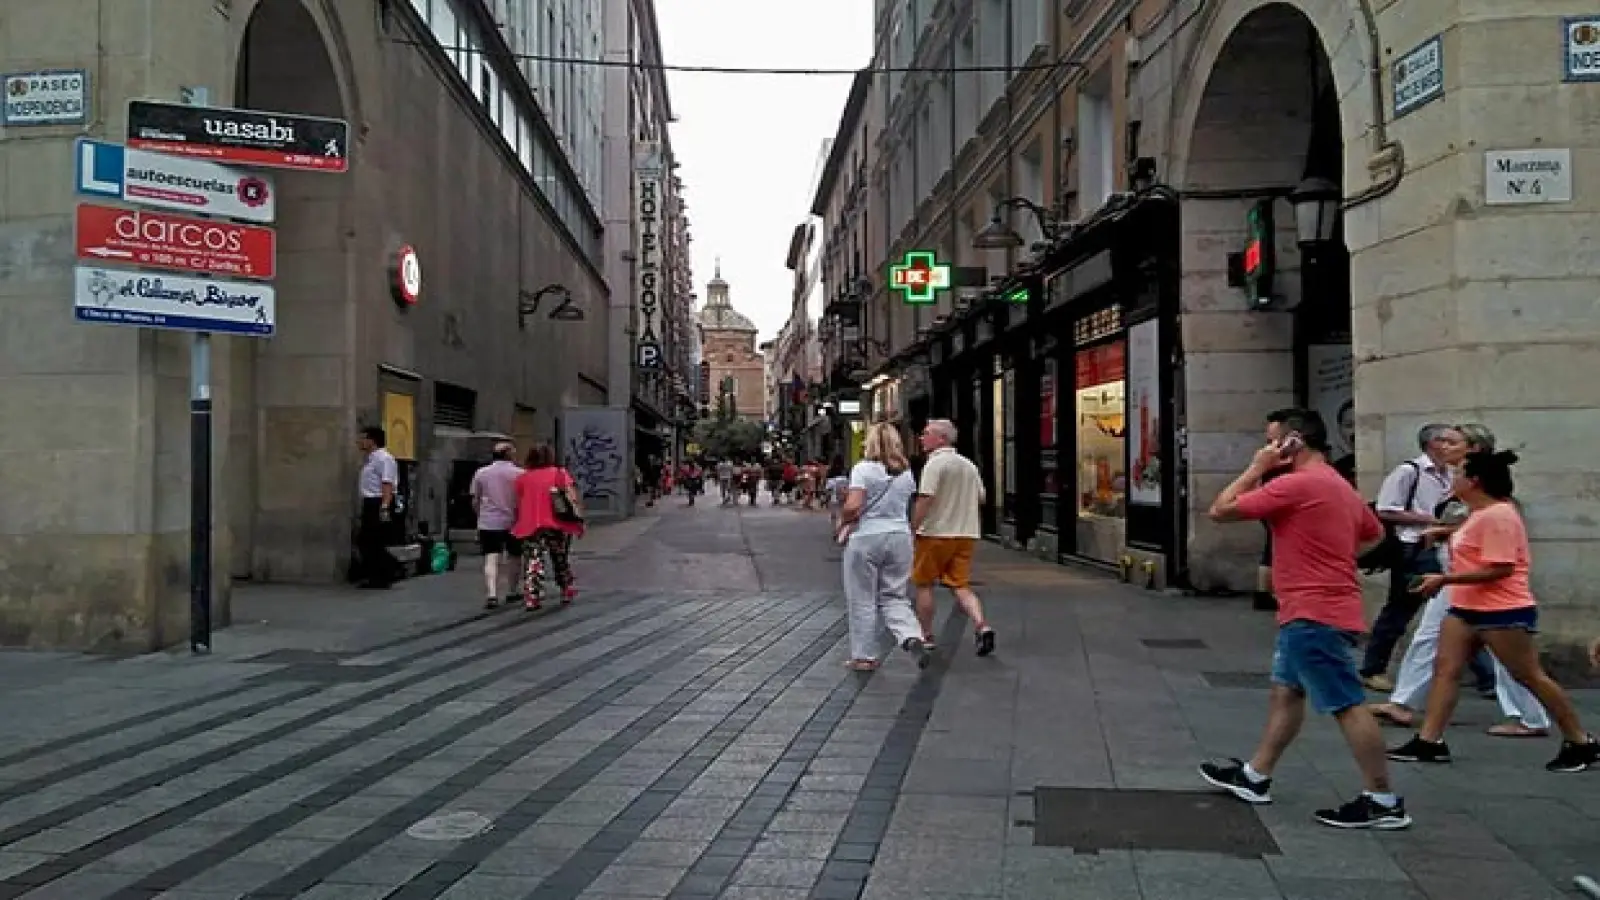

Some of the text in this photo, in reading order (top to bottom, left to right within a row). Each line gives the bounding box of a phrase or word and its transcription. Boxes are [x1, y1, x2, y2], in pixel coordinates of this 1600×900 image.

[31, 78, 81, 92] PASEO
[204, 118, 295, 142] uasabi
[82, 143, 120, 195] L
[126, 167, 233, 195] autoescuelas
[115, 211, 241, 251] darcos
[640, 181, 657, 341] HOTEL GOYA
[640, 346, 657, 365] P
